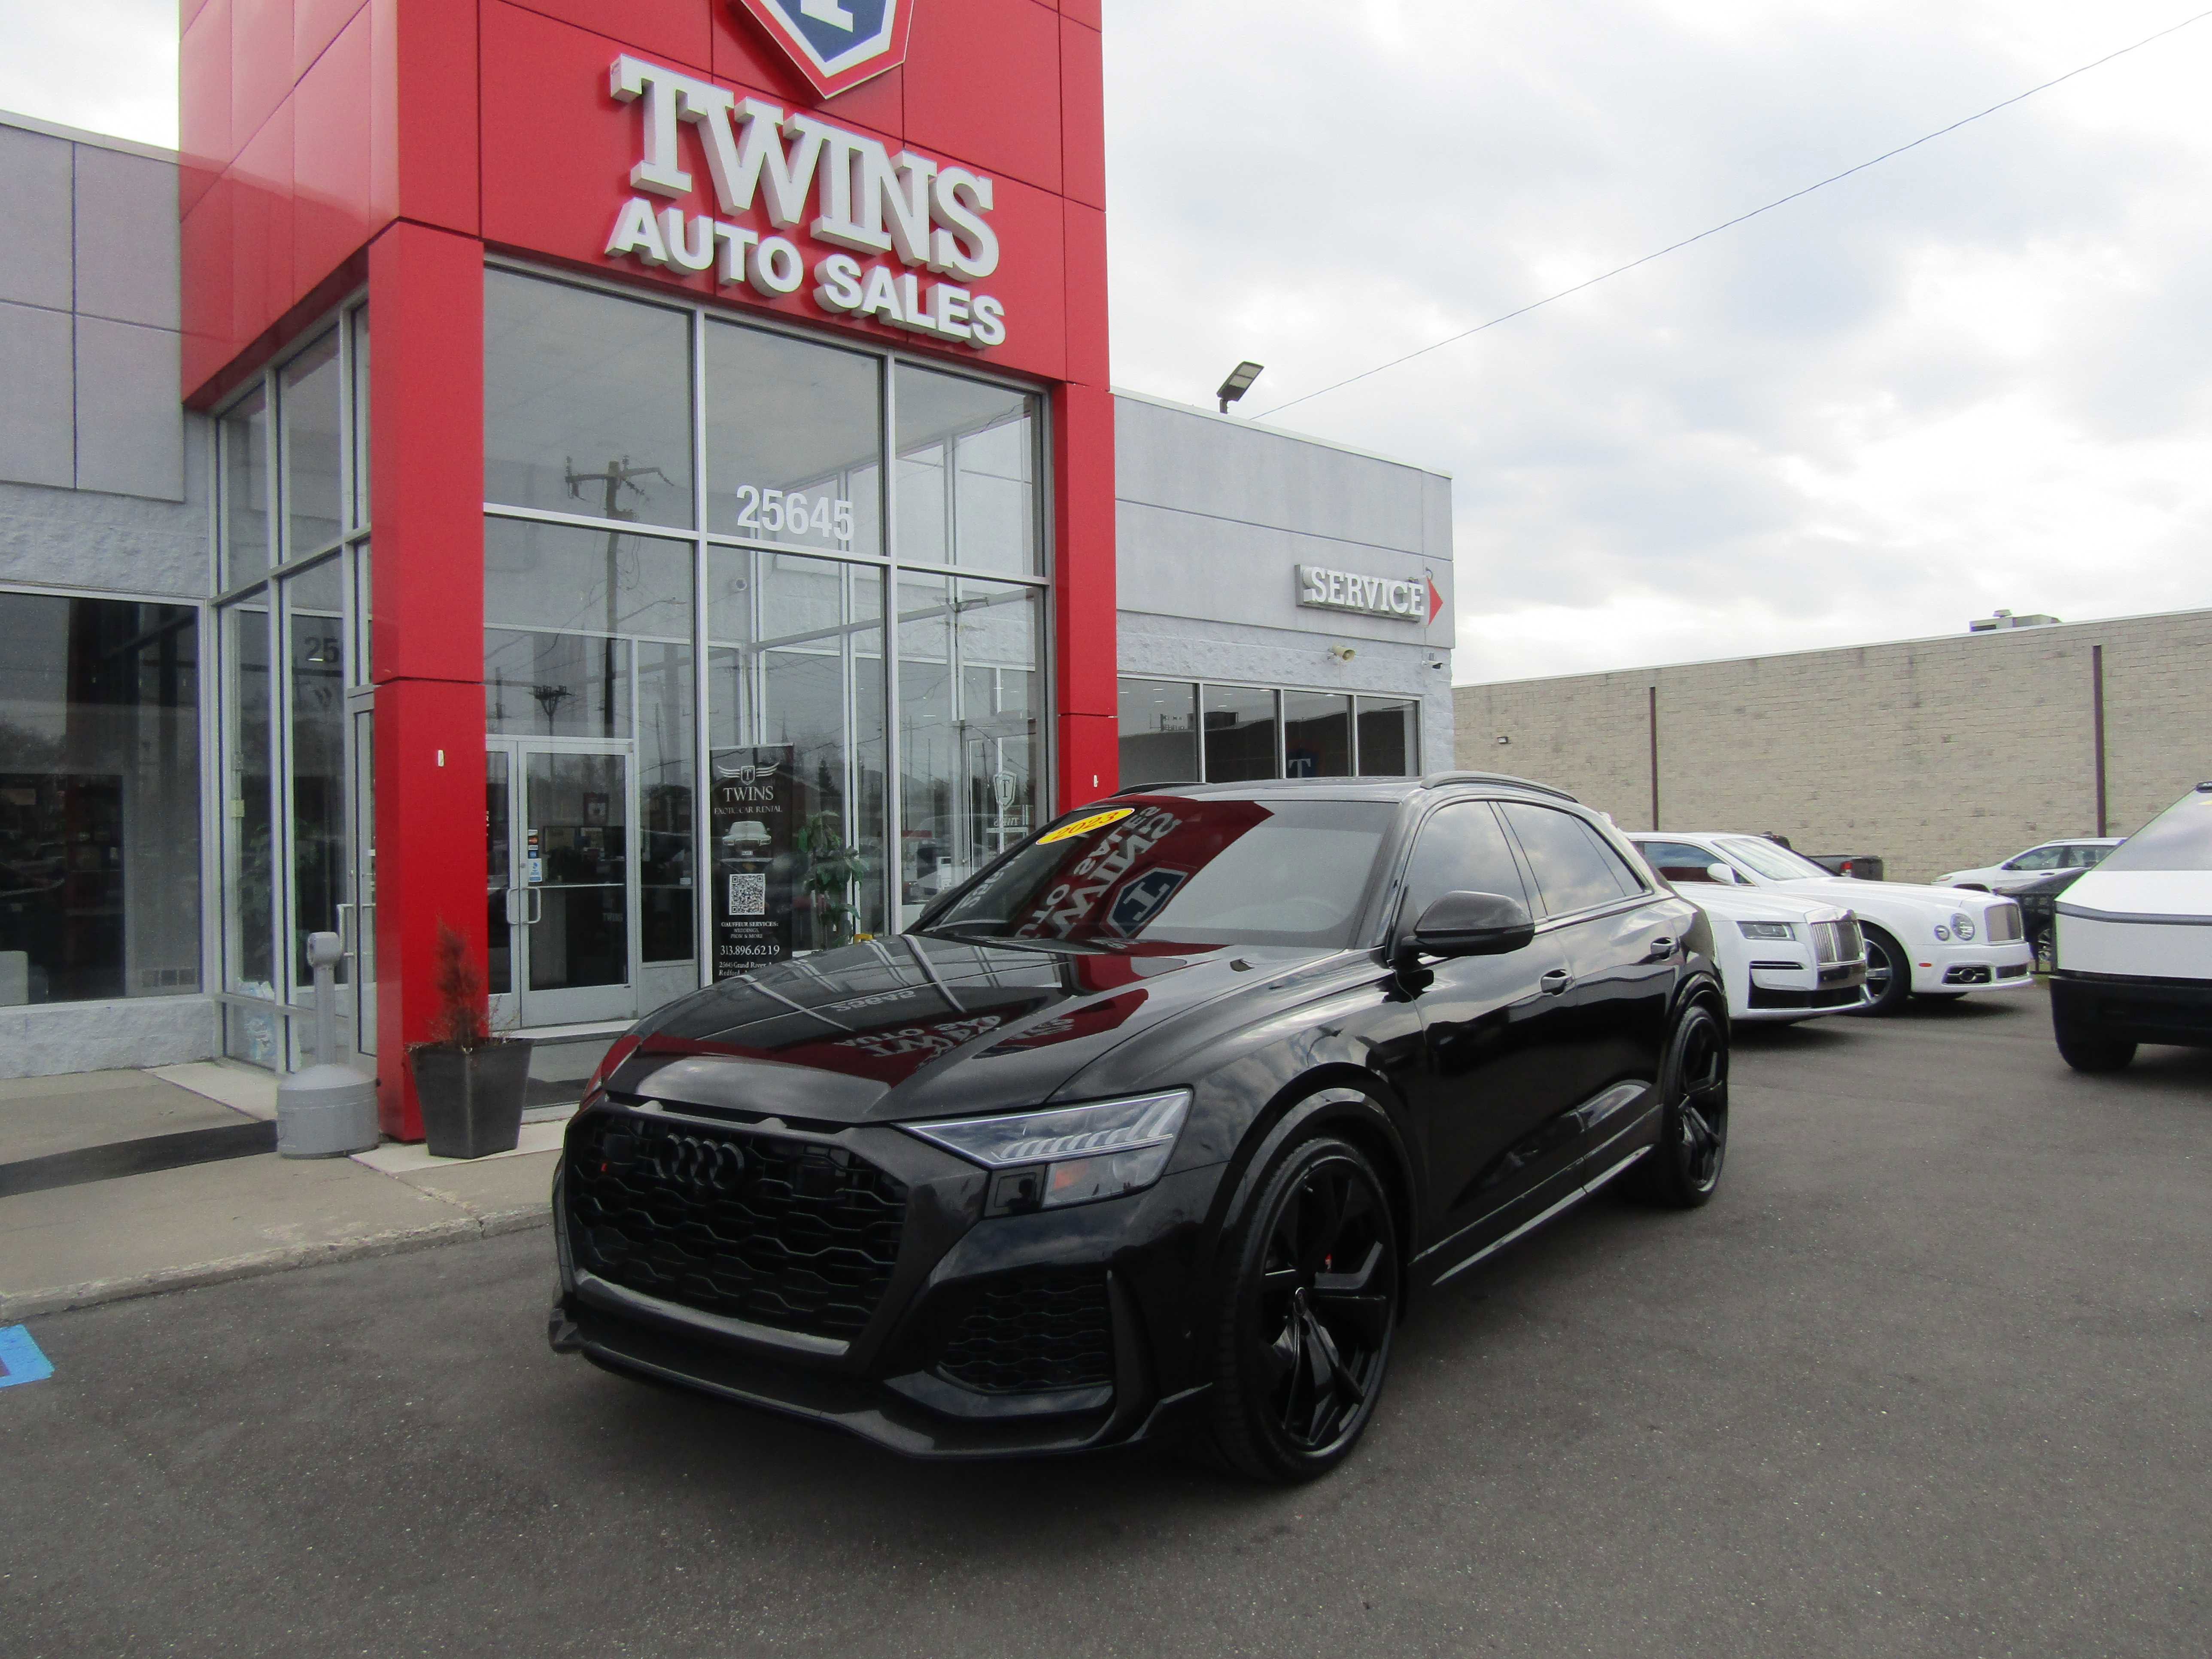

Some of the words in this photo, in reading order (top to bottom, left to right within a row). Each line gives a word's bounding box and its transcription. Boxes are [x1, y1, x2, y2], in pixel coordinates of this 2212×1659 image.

[611, 54, 999, 283] TWINS
[605, 196, 804, 298] AUTO
[814, 253, 1006, 349] SALES
[736, 485, 854, 541] 25645
[1303, 567, 1425, 616] SERVICE
[723, 786, 774, 802] TWINS
[1051, 811, 1119, 840] 2023
[720, 945, 780, 956] 313.896.6219
